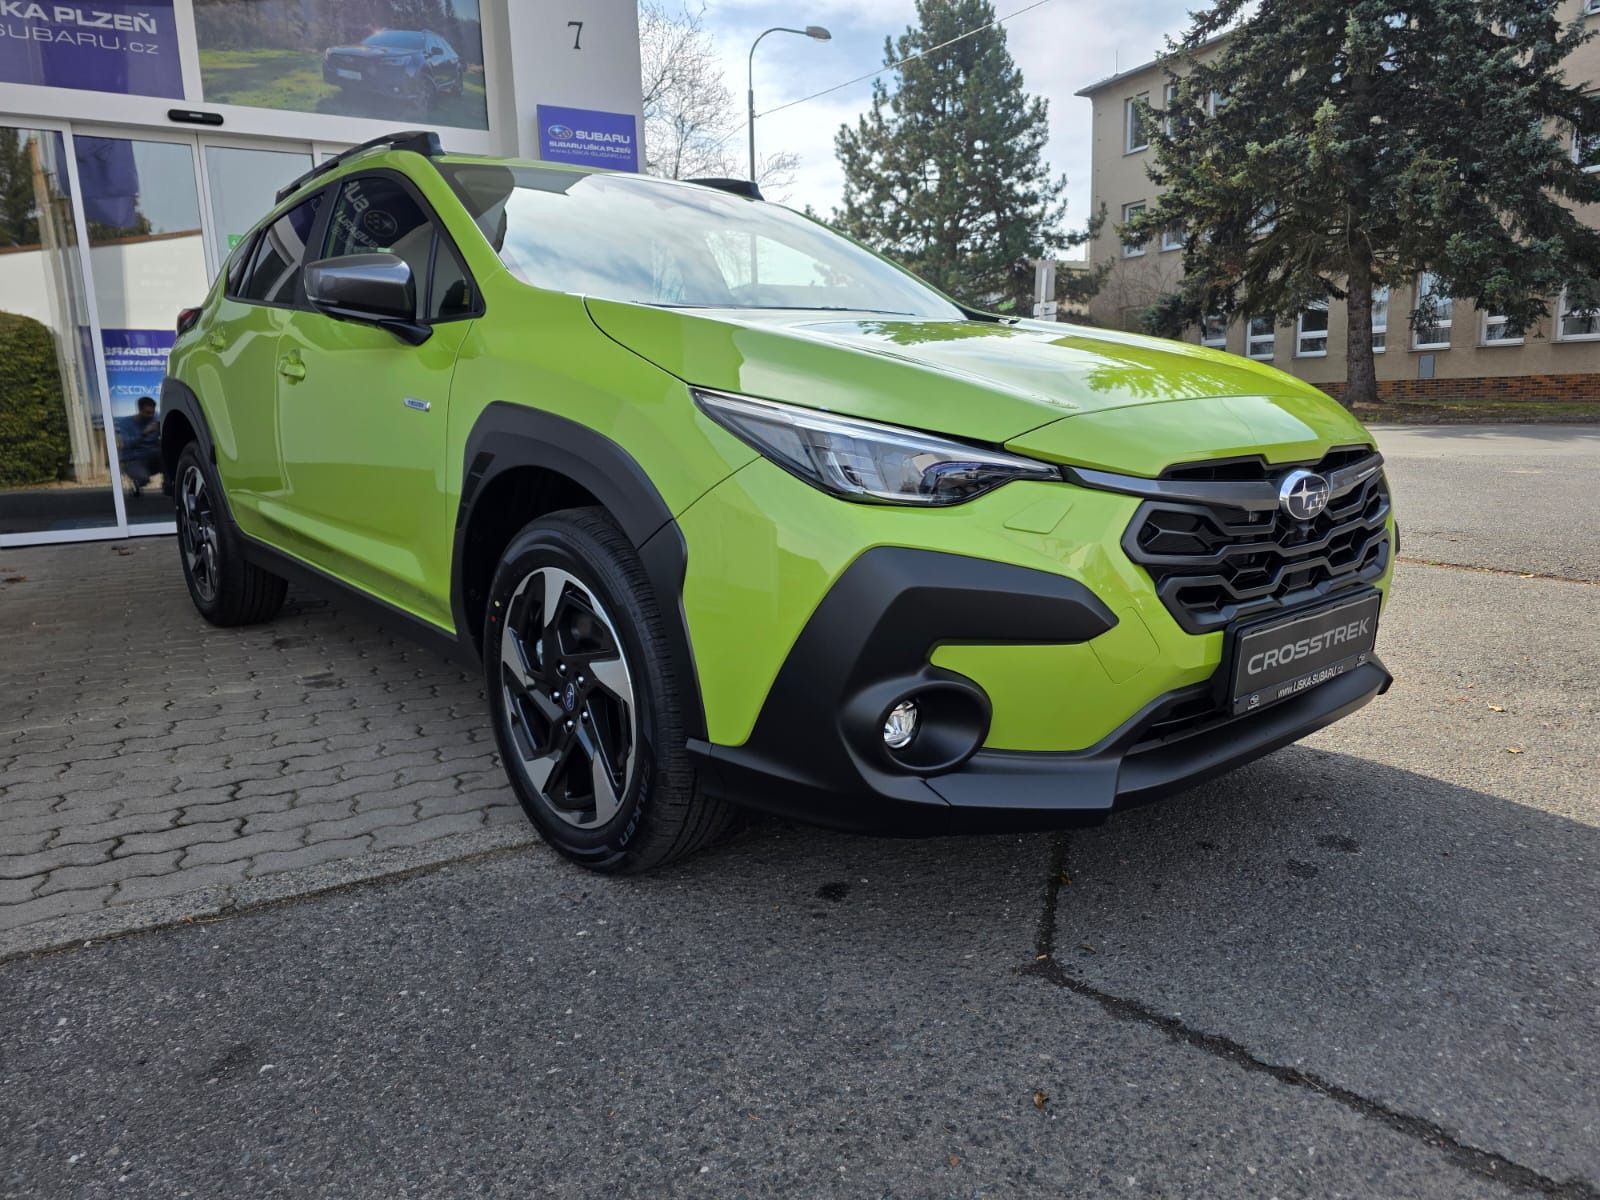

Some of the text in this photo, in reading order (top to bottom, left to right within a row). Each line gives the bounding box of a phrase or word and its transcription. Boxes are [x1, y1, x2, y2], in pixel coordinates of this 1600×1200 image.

[54, 5, 158, 35] PLZEŇ
[567, 21, 583, 50] 7
[549, 140, 583, 150] SUBARU
[575, 130, 630, 144] SUBARU
[1247, 616, 1371, 676] CROSSTREK
